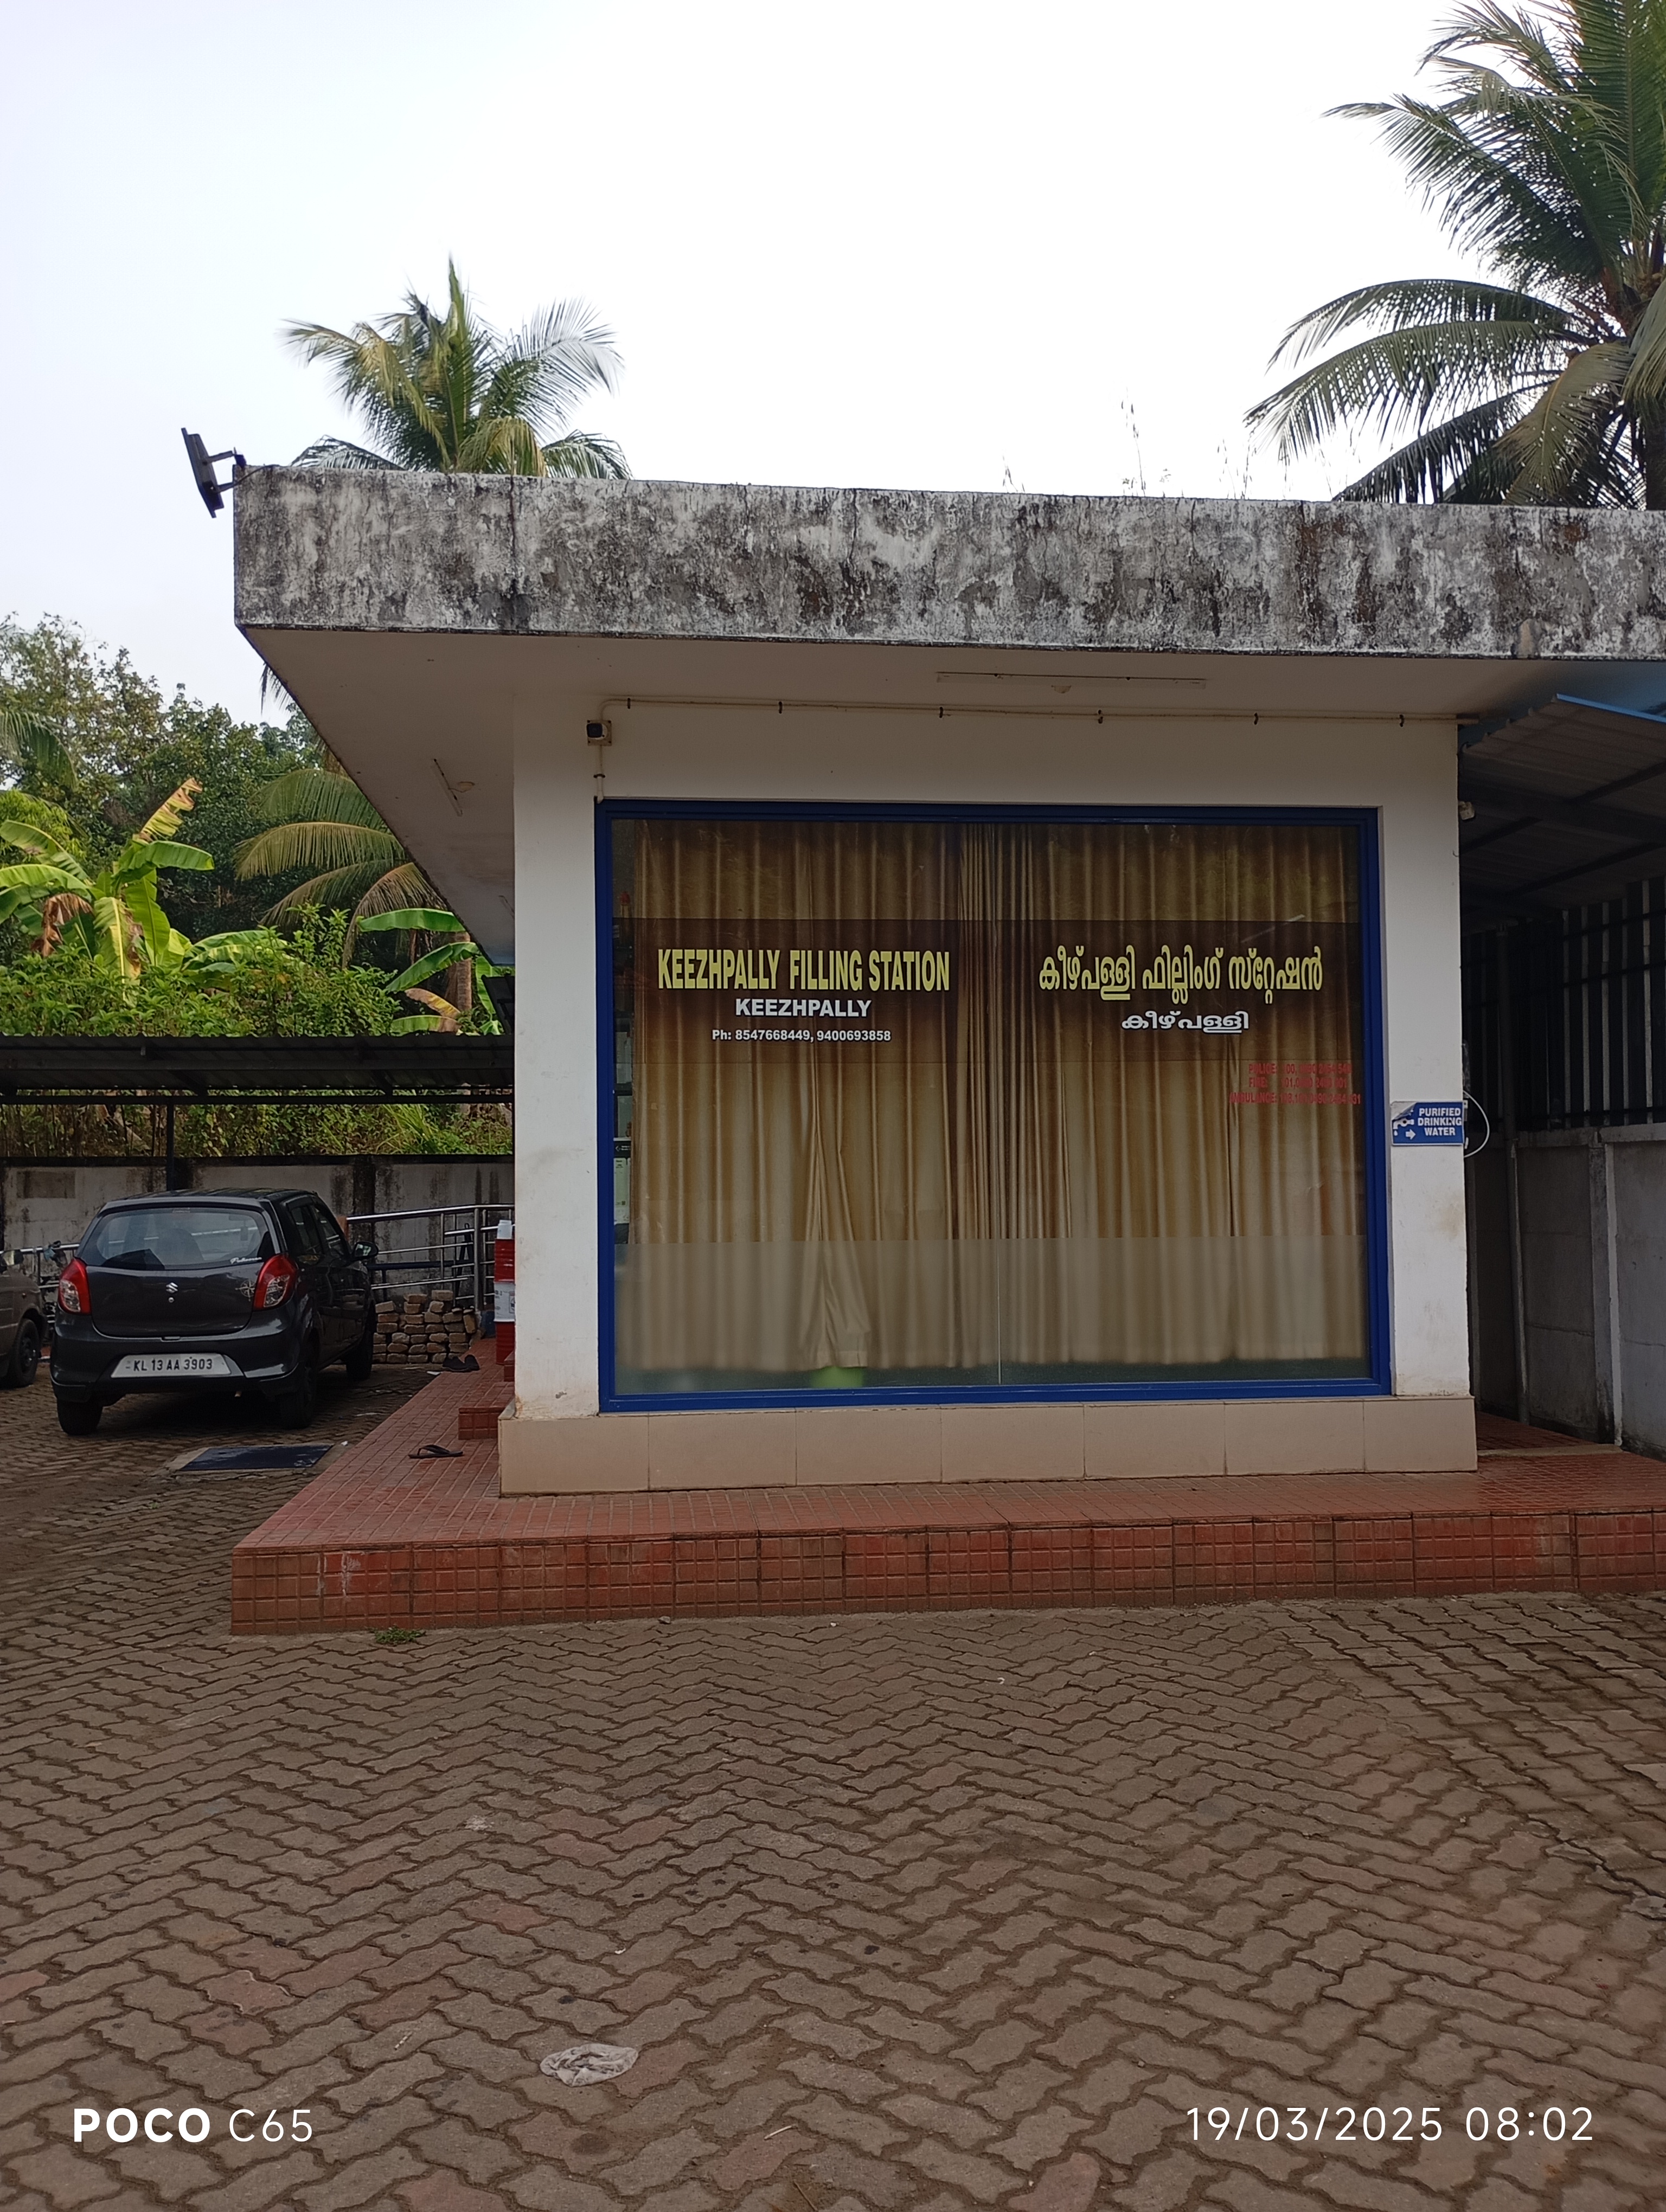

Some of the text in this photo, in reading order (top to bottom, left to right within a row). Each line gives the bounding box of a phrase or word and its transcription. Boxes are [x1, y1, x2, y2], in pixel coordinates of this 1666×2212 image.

[658, 949, 950, 992] KEEZHPALLY FILLING STATION
[1039, 946, 1136, 1000] കീഴ്പള്ളി
[1142, 945, 1223, 1004] ഫില്ലിംഗ്
[735, 998, 872, 1017] KEEZHPALLY
[1122, 1011, 1249, 1033] കീഴ്പള്ളി
[712, 1030, 891, 1043] Ph: 8547668449, 9400693858
[1419, 1108, 1461, 1116] PURIFIED
[1418, 1117, 1462, 1126] DRINKING
[1424, 1127, 1456, 1136] WATER
[133, 1360, 148, 1371] KL
[151, 1359, 163, 1371] 13
[166, 1359, 180, 1370] AA
[184, 1359, 212, 1369] 3903
